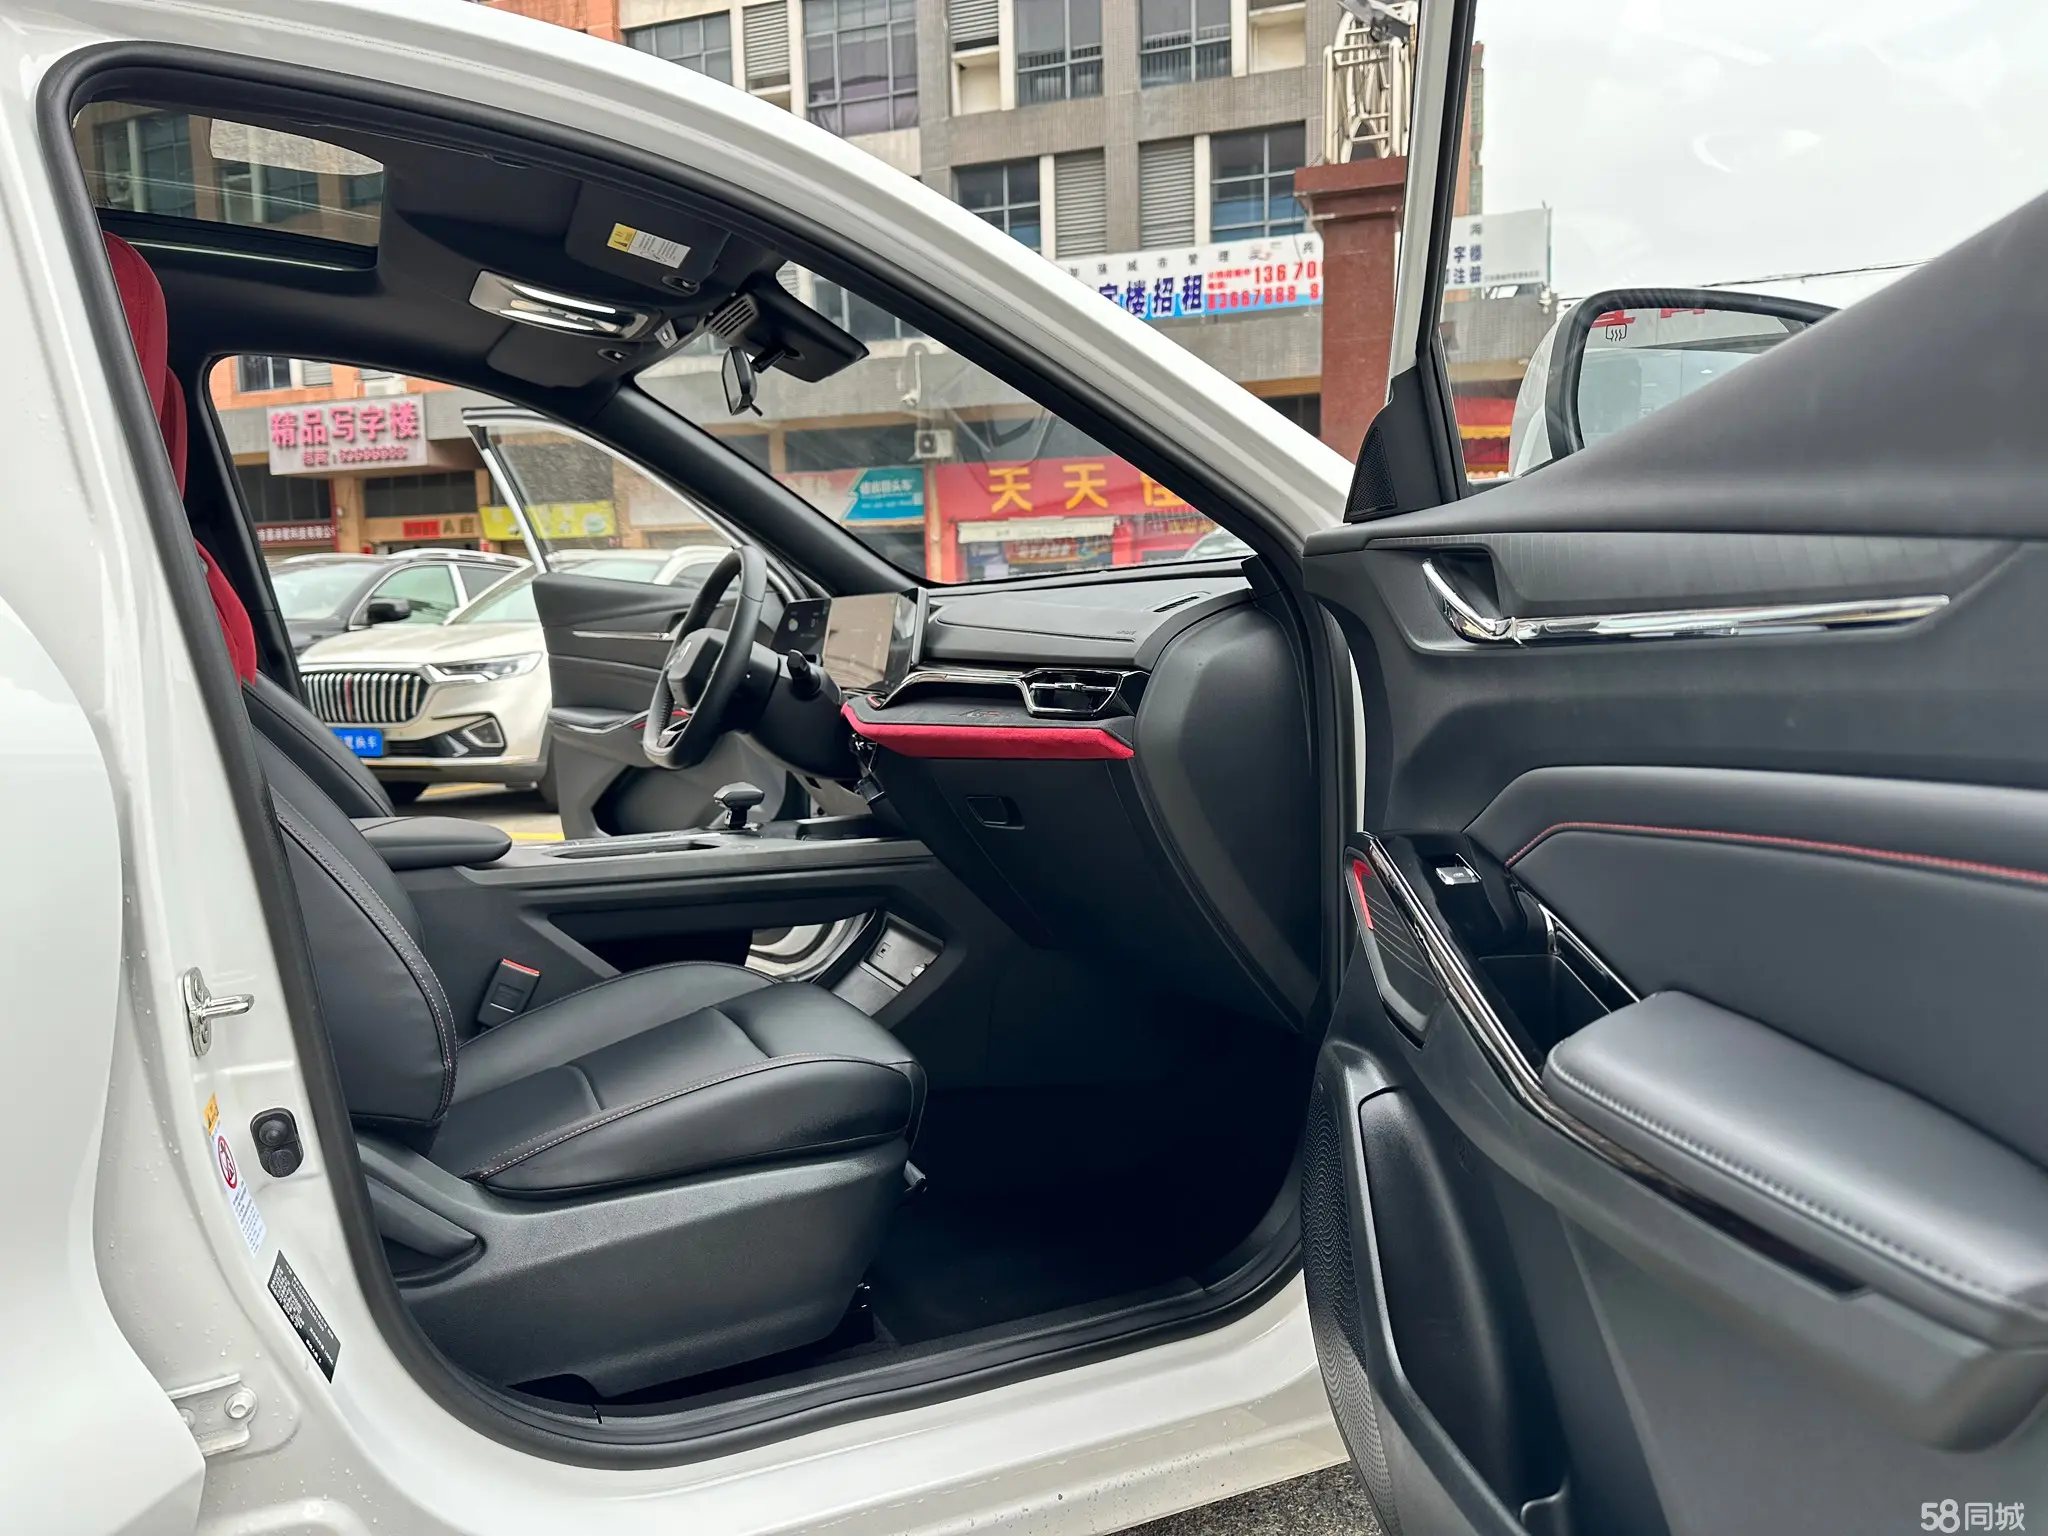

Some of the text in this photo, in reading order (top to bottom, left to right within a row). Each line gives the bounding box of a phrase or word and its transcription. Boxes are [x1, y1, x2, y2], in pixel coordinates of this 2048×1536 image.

[271, 400, 419, 448] 精品写字楼
